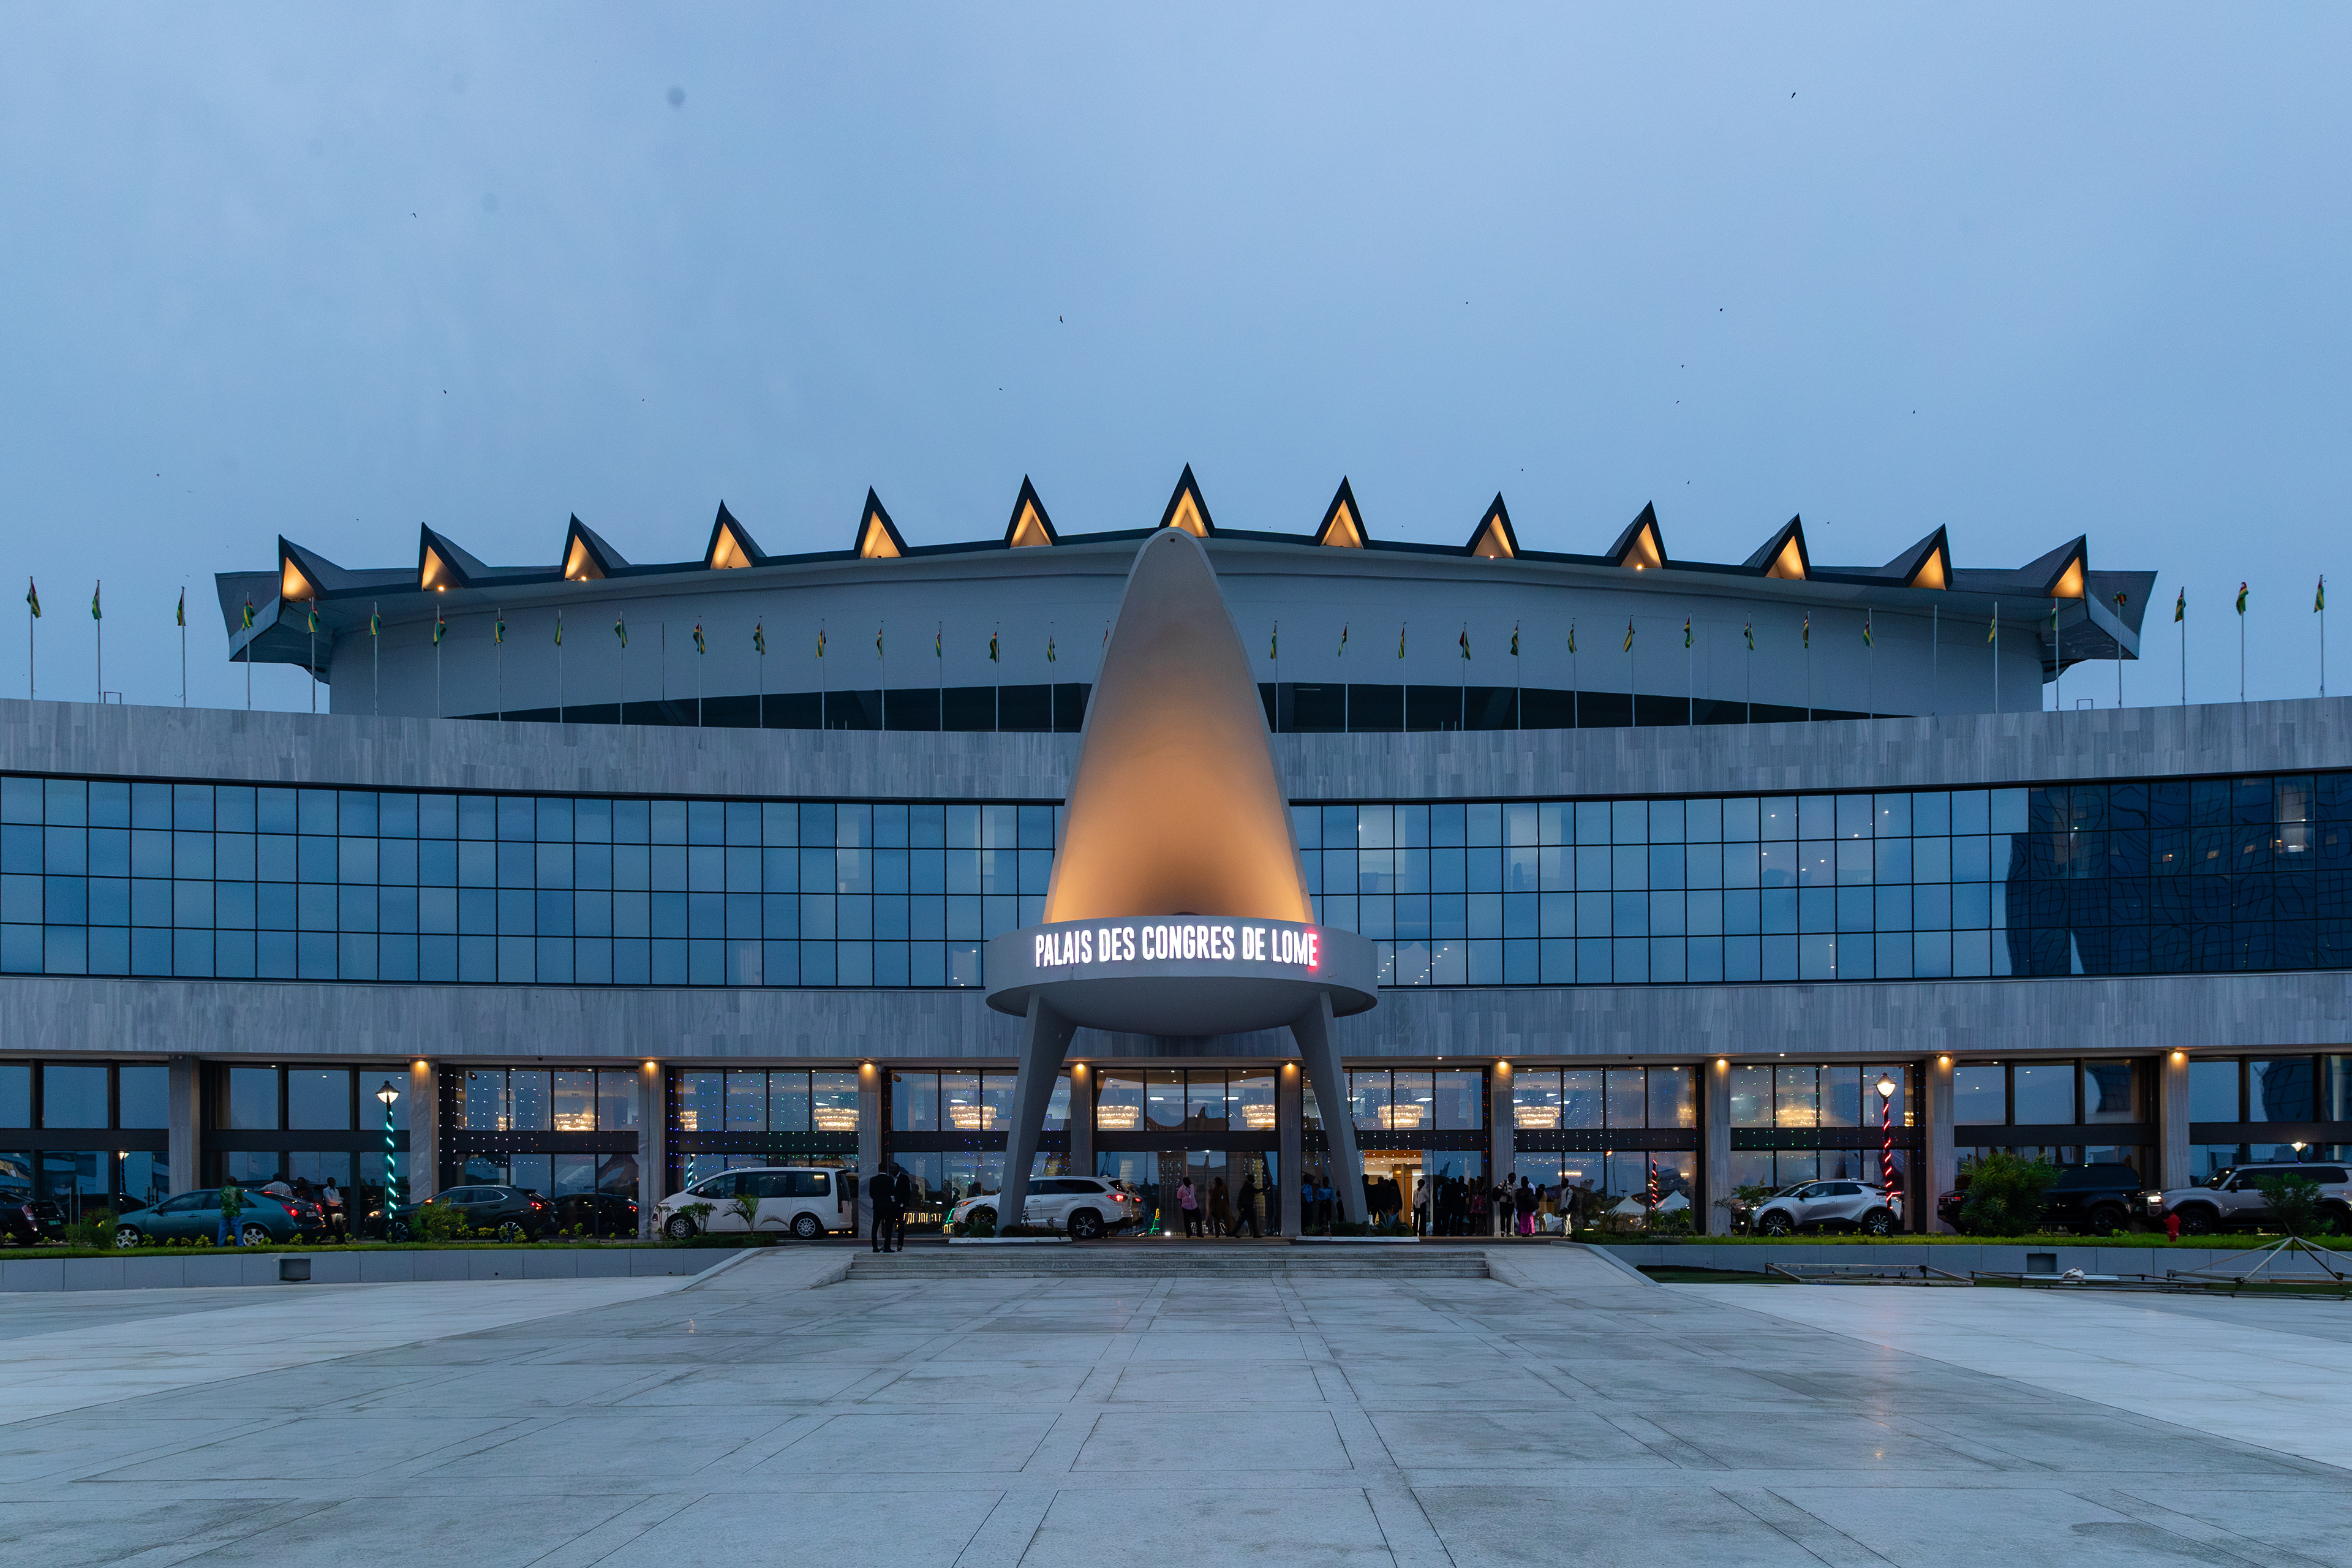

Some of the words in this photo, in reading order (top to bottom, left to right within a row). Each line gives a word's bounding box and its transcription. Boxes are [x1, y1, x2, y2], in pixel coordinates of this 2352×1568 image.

[1035, 929, 1092, 968] PALAIS
[1098, 927, 1136, 962] DES
[1142, 925, 1235, 960] CONGRES
[1242, 926, 1265, 961] DE
[1272, 929, 1317, 967] LOME
